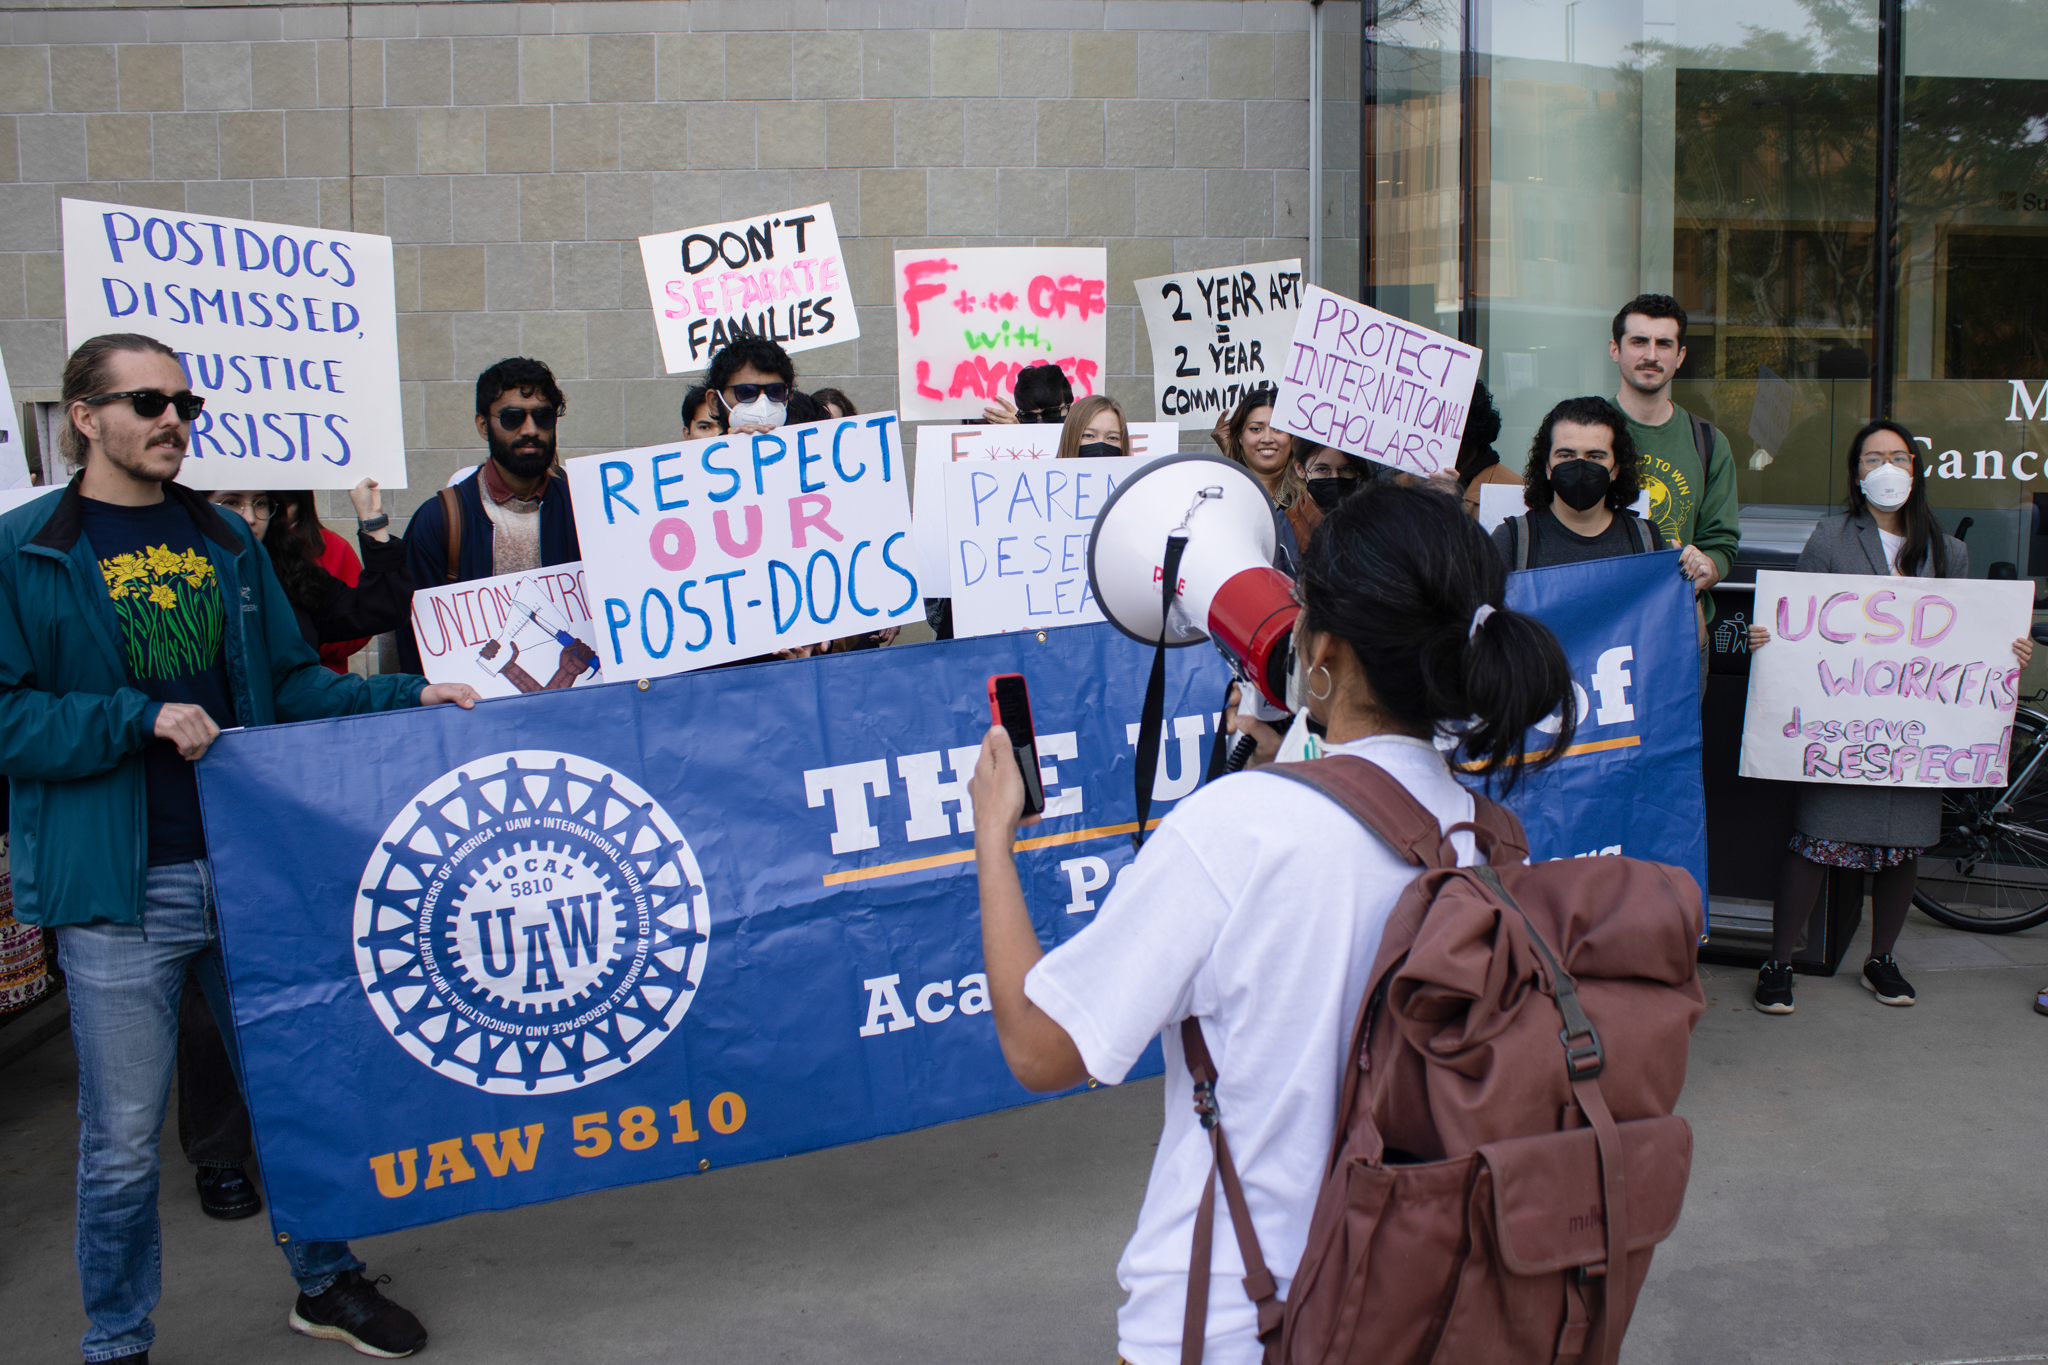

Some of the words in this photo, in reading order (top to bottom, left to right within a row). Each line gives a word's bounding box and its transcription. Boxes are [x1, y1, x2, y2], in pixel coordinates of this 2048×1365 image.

[102, 212, 356, 288] POSTDOCS
[681, 215, 816, 275] DON'T
[102, 277, 364, 339] DISMISSED,
[664, 256, 840, 320] SEPARATE
[1027, 274, 1107, 322] OFF
[1161, 282, 1193, 322] 2
[1197, 271, 1264, 322] YEAR
[964, 320, 1052, 352] with
[1174, 345, 1200, 378] 2
[1208, 339, 1265, 376] YEAR
[1313, 298, 1470, 387] PROTECT
[174, 352, 346, 394] JUSTICE
[1284, 341, 1465, 441] INTERNATIONAL
[183, 409, 351, 467] RSISTS
[1288, 393, 1443, 474] SCHOLARS
[1913, 437, 2048, 481] anc
[599, 415, 897, 525] RESPECT
[1655, 457, 1671, 472] TO
[1671, 469, 1691, 496] WIN
[649, 493, 845, 572] OUR
[604, 531, 919, 665] POST-DOCS
[1153, 565, 1186, 597] PE
[1776, 589, 1958, 648] UCSD
[1818, 656, 2021, 712] WORKERS
[1782, 706, 1926, 745] deserve
[1803, 725, 2013, 785] RESPECT!
[803, 731, 1084, 855] THE
[449, 828, 496, 867] AMERICA
[505, 817, 532, 832] UAW
[543, 817, 621, 864] INTERNATIONAL
[437, 863, 453, 881] OF
[485, 858, 575, 893] LOCAL
[510, 877, 554, 898] 5810
[618, 860, 643, 894] UNION
[419, 879, 444, 934] WORKERS
[634, 894, 650, 936] UNITED
[419, 937, 452, 995] IMPLEMENT
[471, 891, 603, 994] UAW
[610, 938, 649, 1004] AUTOMOBILE
[447, 991, 524, 1036] AGRICULTURAL
[525, 1025, 549, 1036] AND
[552, 1000, 613, 1035] AEROSPACE
[369, 1123, 545, 1199] UAW
[572, 1091, 747, 1158] 5810
